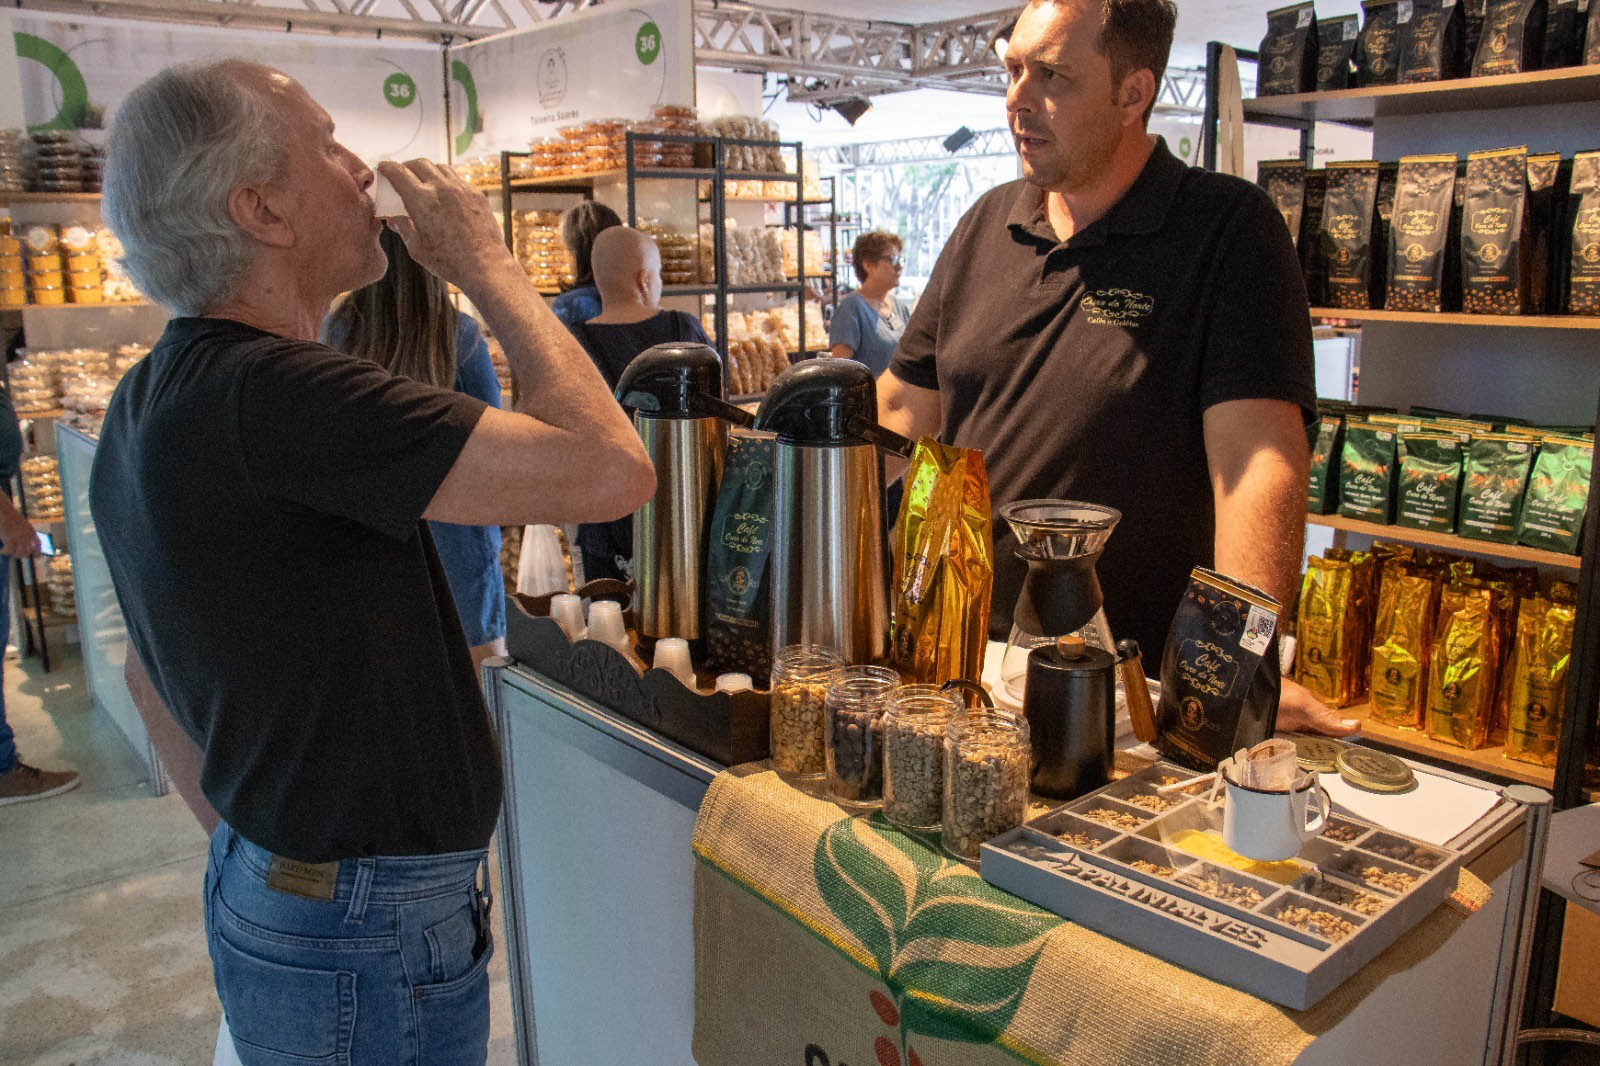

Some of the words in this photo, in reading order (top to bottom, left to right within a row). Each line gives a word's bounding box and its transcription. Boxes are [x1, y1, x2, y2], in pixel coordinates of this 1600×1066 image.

[639, 35, 656, 52] 36
[390, 83, 410, 97] 36
[1480, 488, 1504, 502] Café
